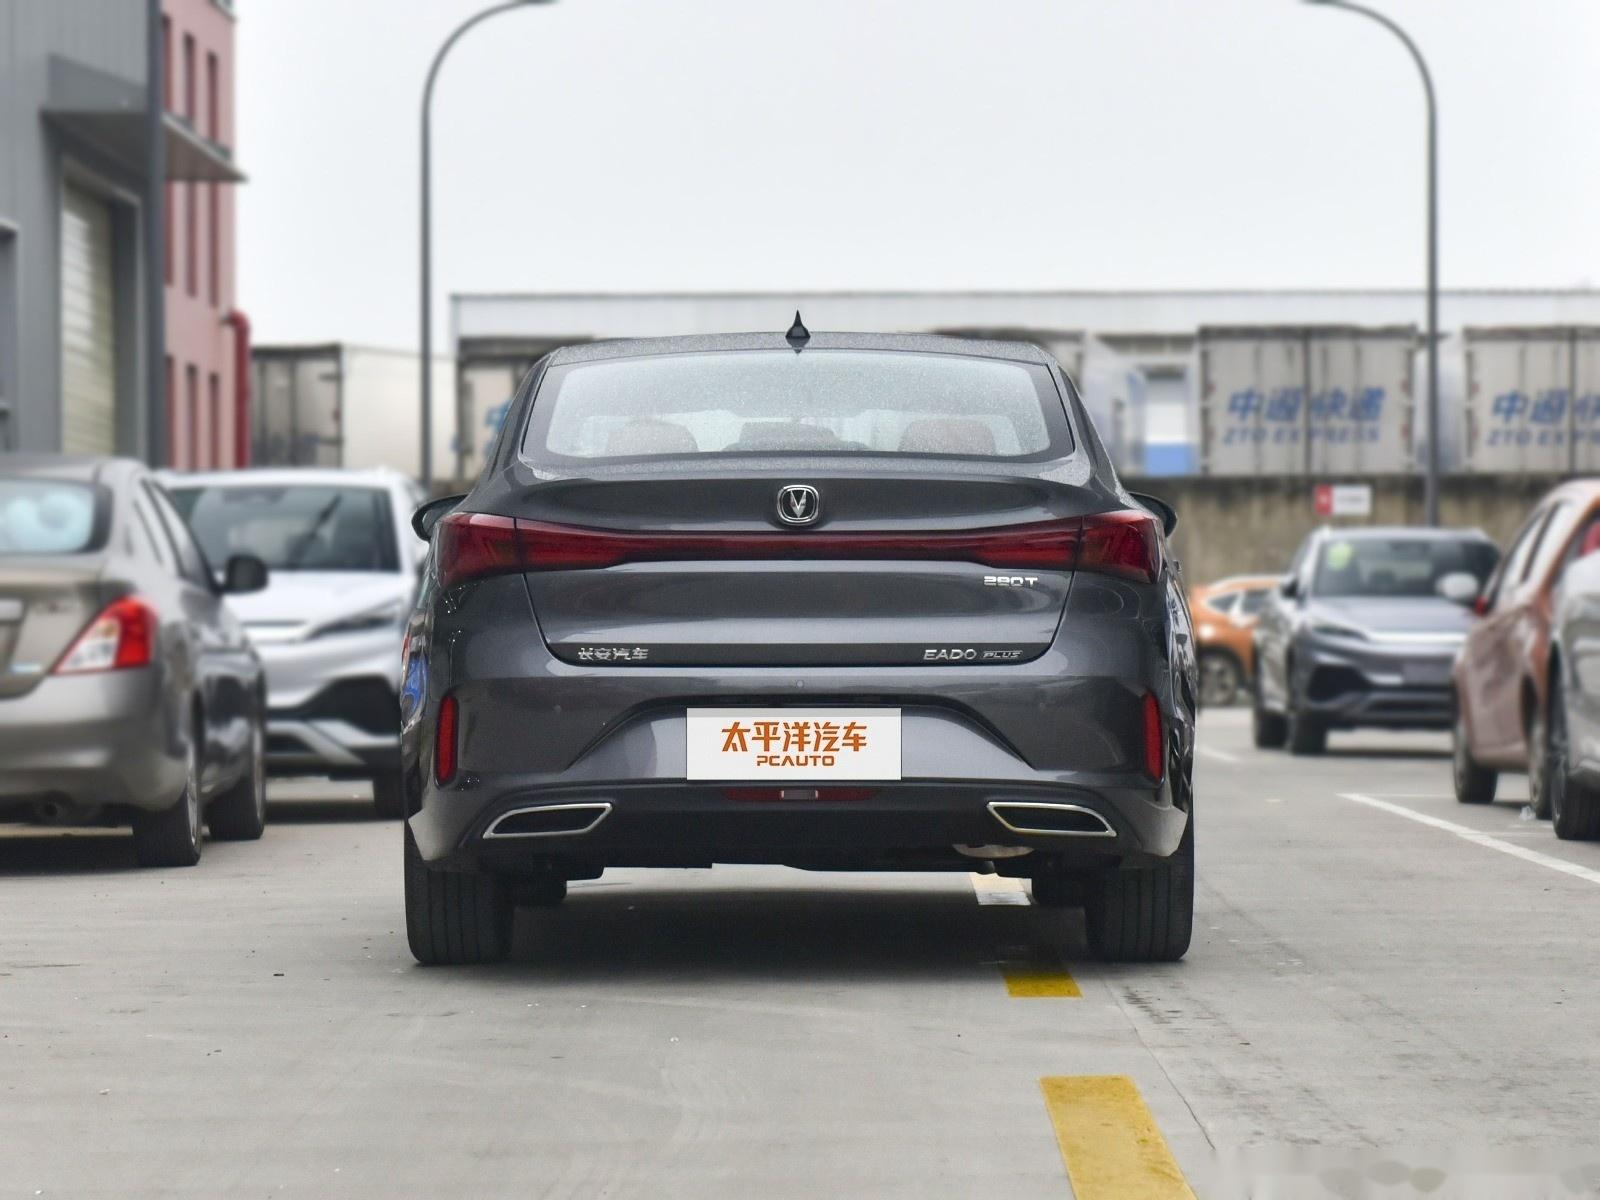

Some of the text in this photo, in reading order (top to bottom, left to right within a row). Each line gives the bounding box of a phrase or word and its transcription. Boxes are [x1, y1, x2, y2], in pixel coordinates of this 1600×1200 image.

[577, 647, 649, 661] 长安汽车
[923, 648, 1023, 660] EADO PLUS
